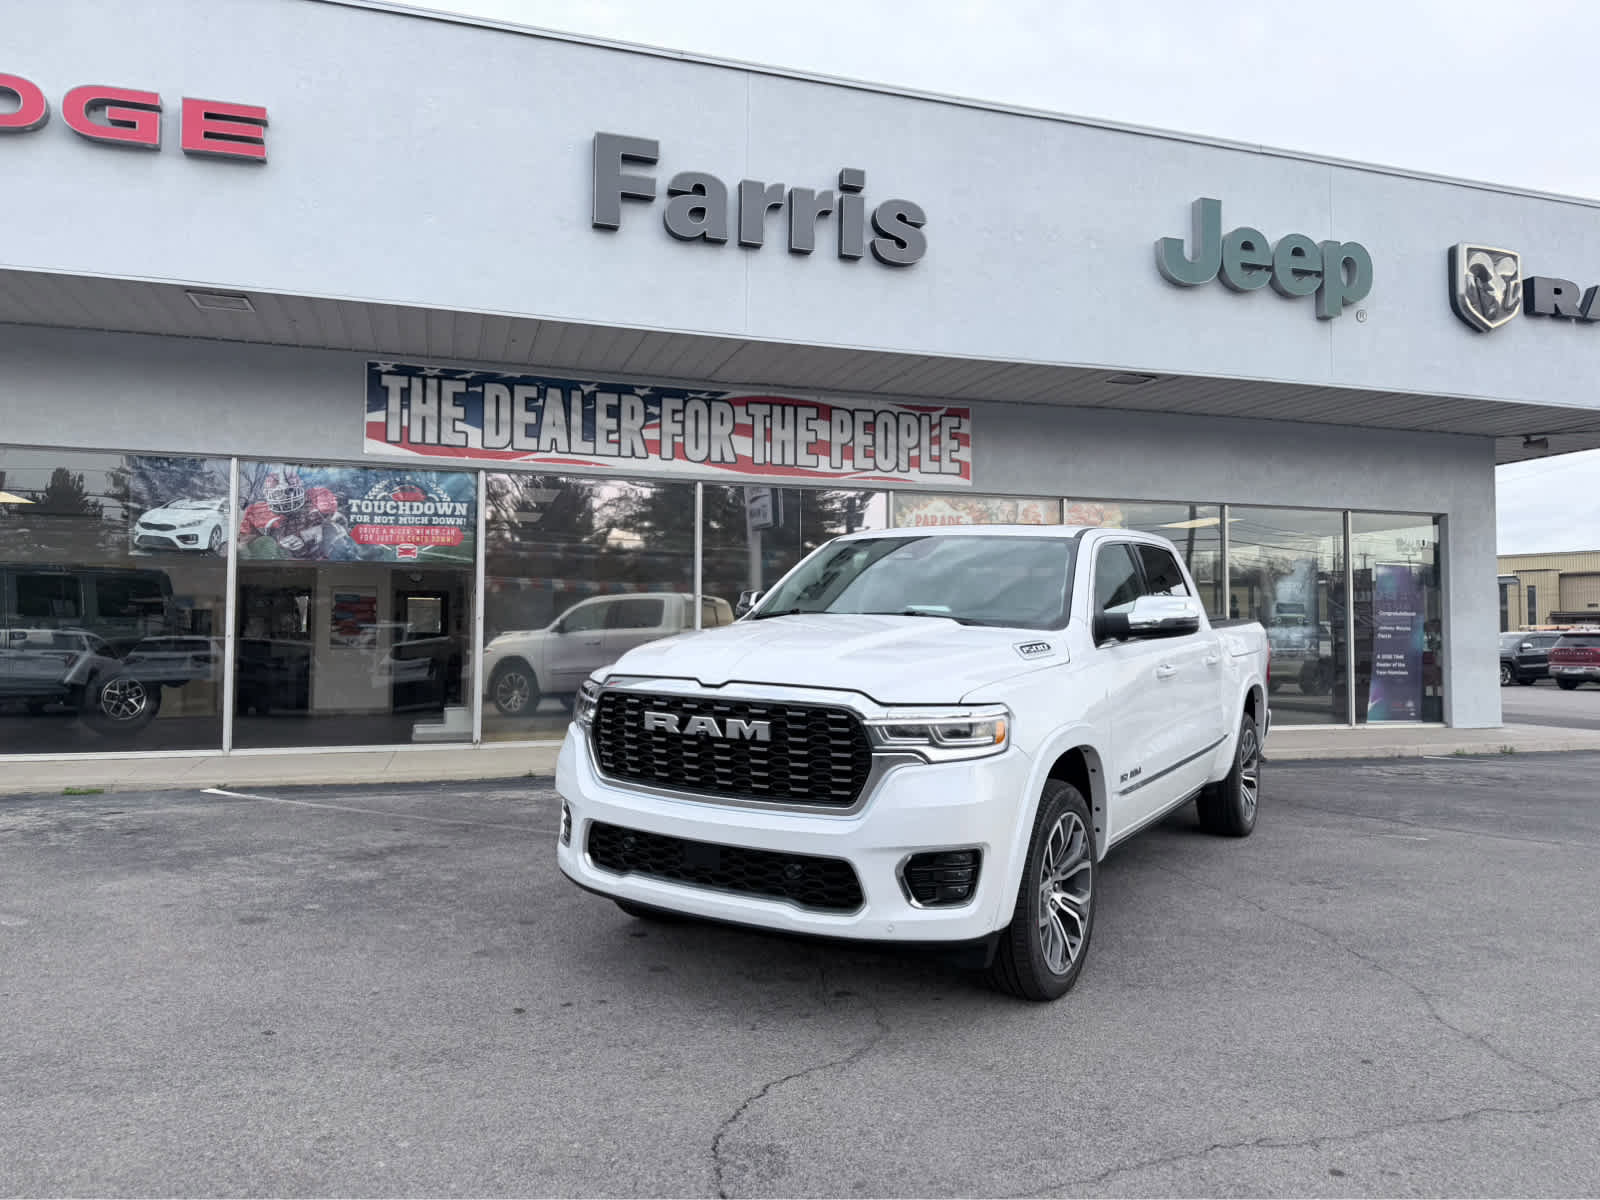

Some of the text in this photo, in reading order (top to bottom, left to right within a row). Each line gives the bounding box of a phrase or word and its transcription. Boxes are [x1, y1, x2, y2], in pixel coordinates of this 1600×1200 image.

[593, 131, 927, 266] Farris
[1156, 197, 1374, 320] Jeep
[1523, 276, 1600, 322] R
[381, 374, 962, 475] THE DEALER FOR THE PEOPLE
[348, 499, 468, 516] TOUCHDOWN
[350, 514, 467, 526] FOR NOT MUCH DOWN!
[644, 711, 771, 742] RAM
